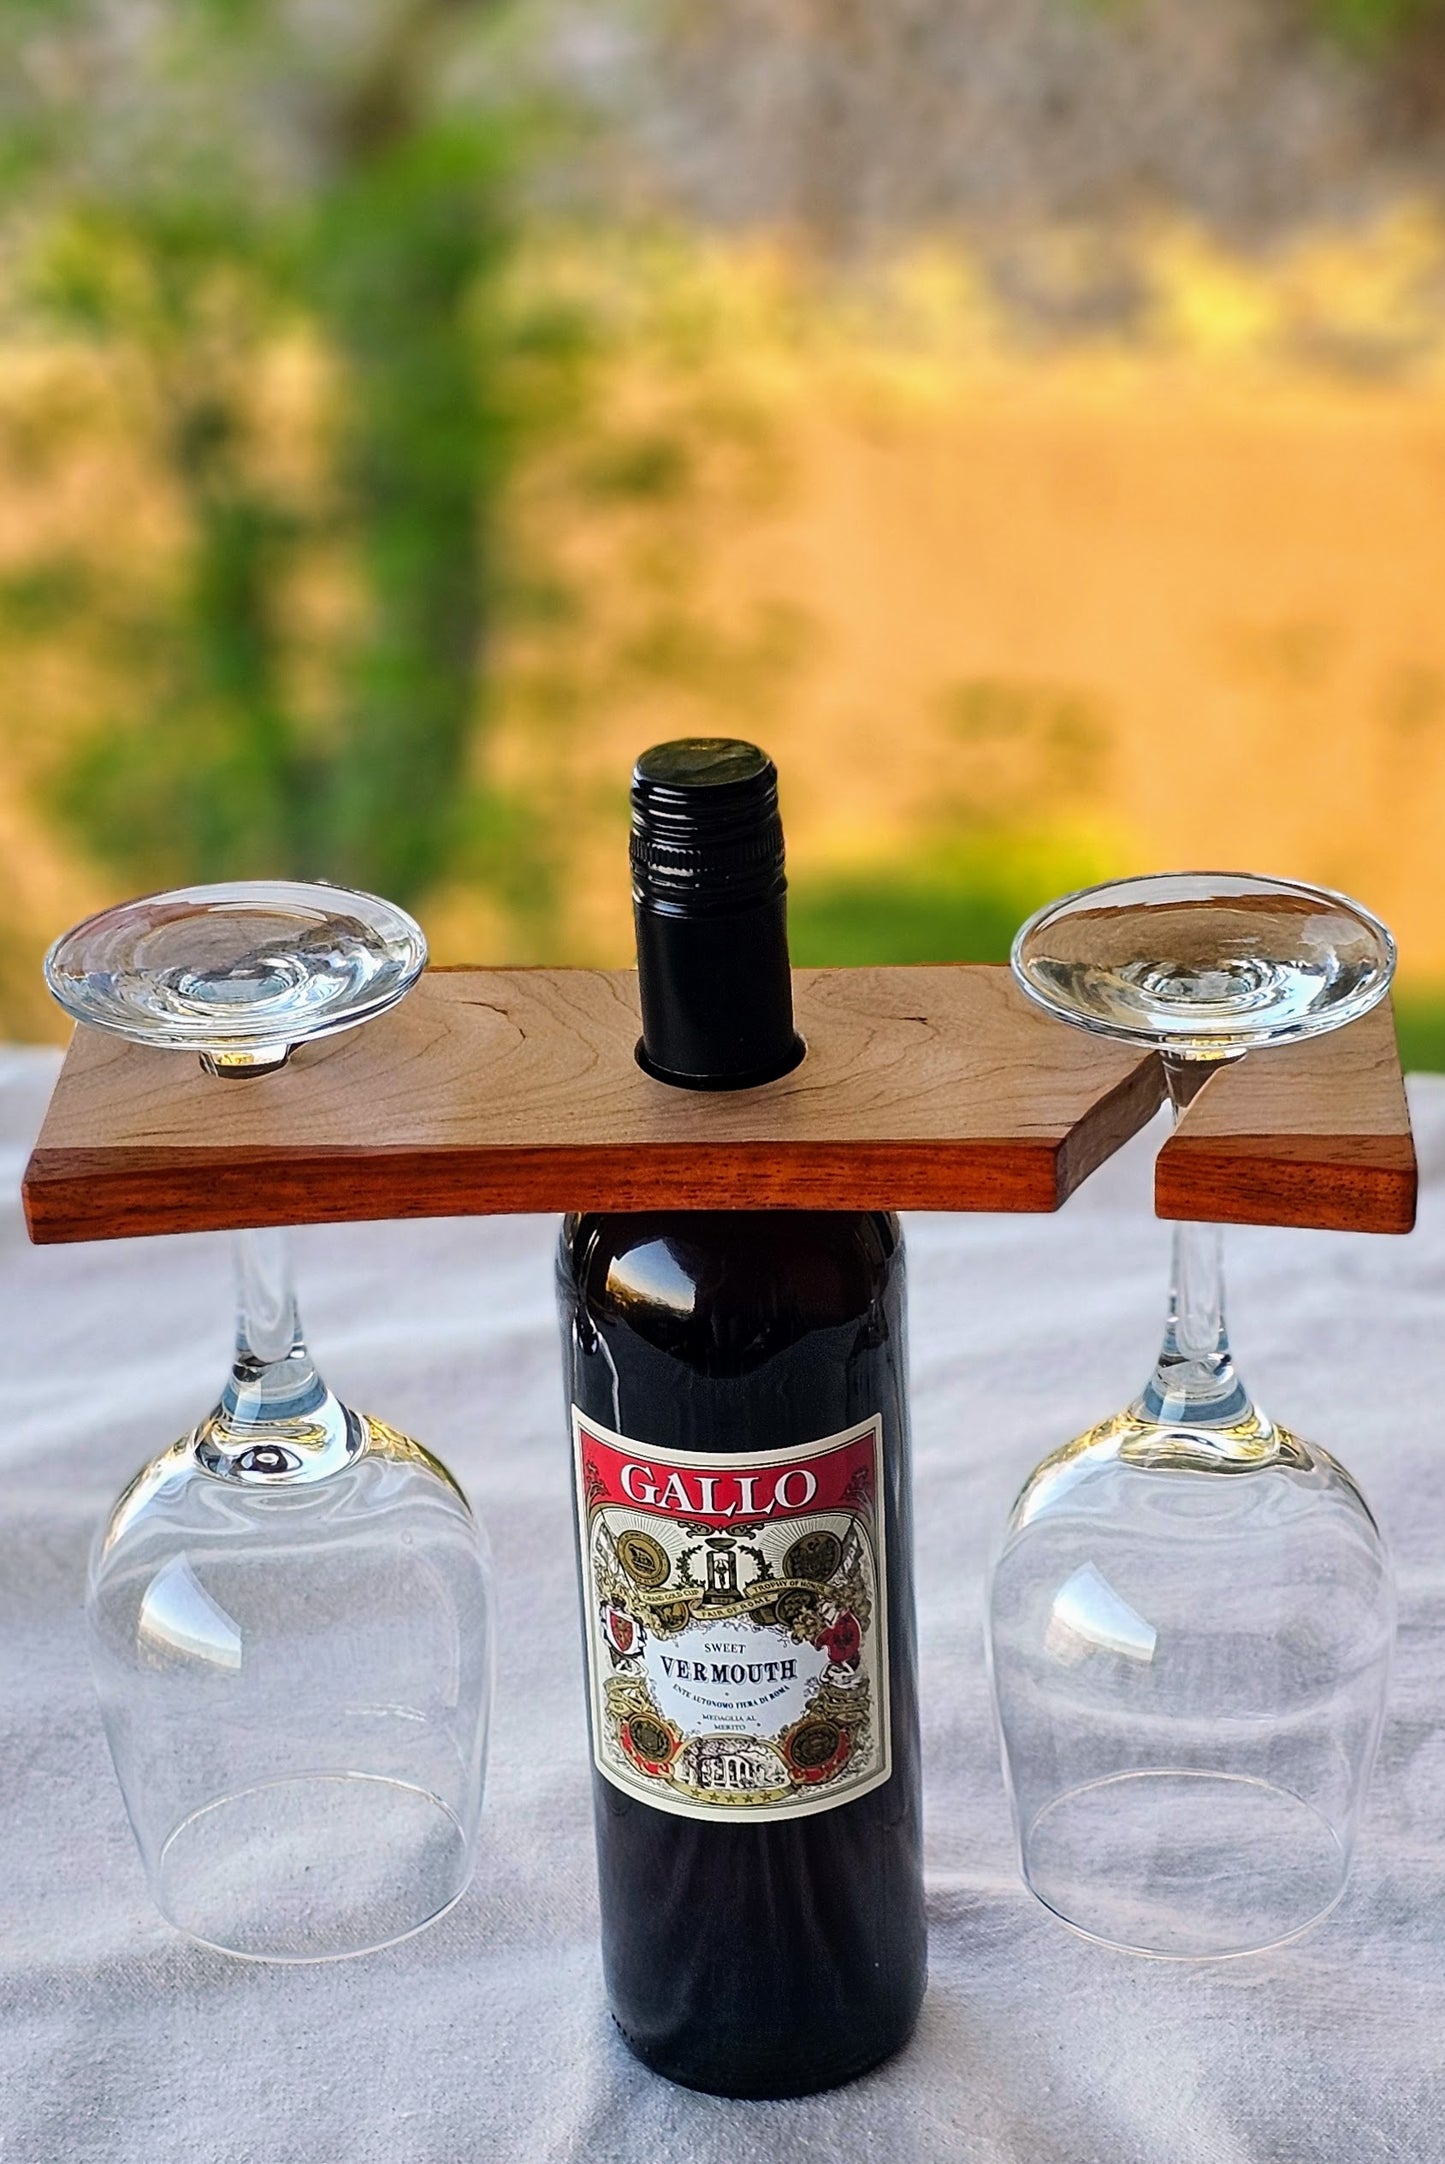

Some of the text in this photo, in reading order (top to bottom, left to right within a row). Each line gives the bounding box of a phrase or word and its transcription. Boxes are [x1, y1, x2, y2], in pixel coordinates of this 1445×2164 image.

[620, 1463, 817, 1517] GALLO
[753, 1580, 788, 1593] TROPHY
[665, 1592, 683, 1600] GOLD
[683, 1589, 700, 1597] CUP
[701, 1610, 724, 1618] FAIR
[740, 1596, 770, 1609] ROME
[704, 1642, 746, 1654] SWEET
[660, 1655, 798, 1685] VERMOUTH
[672, 1683, 790, 1709] ENTE AUTONOMO FIERA DI ROMA
[702, 1713, 744, 1721] MEDAGLIA
[714, 1723, 746, 1731] MERITO
